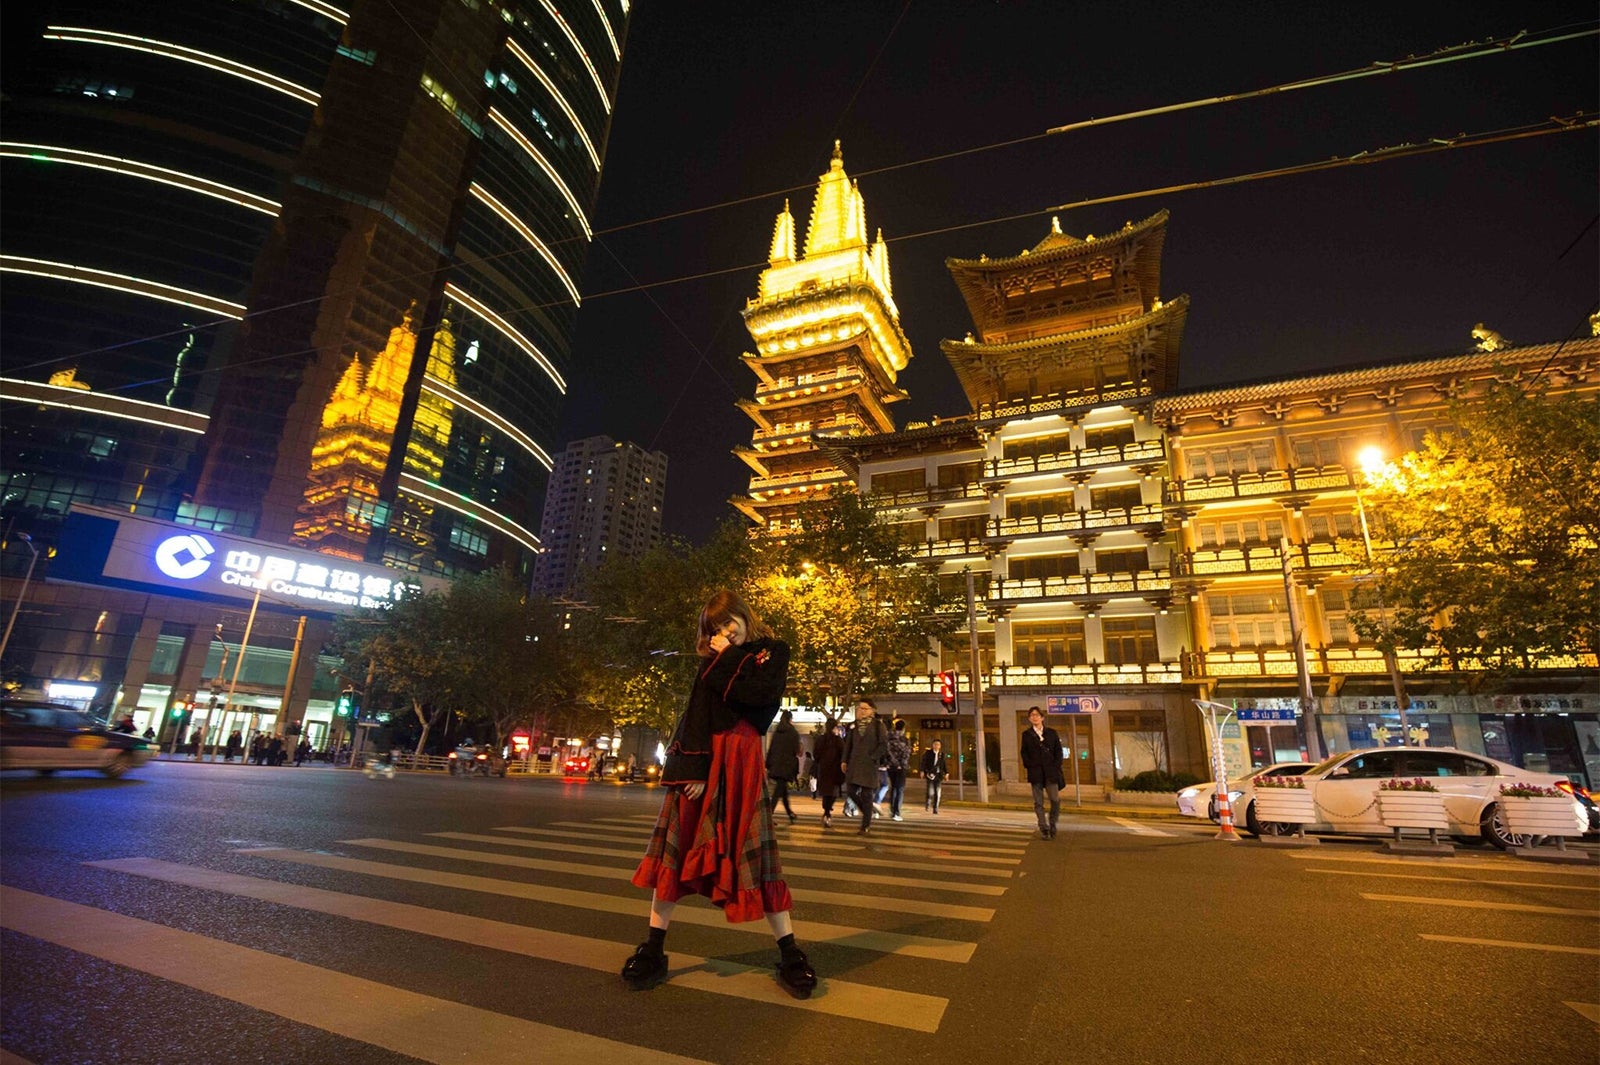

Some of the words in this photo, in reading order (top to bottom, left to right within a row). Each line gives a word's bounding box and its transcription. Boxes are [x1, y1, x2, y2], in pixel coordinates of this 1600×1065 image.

[221, 571, 268, 590] China
[271, 580, 358, 606] Construction
[1251, 710, 1280, 720] 华山路
